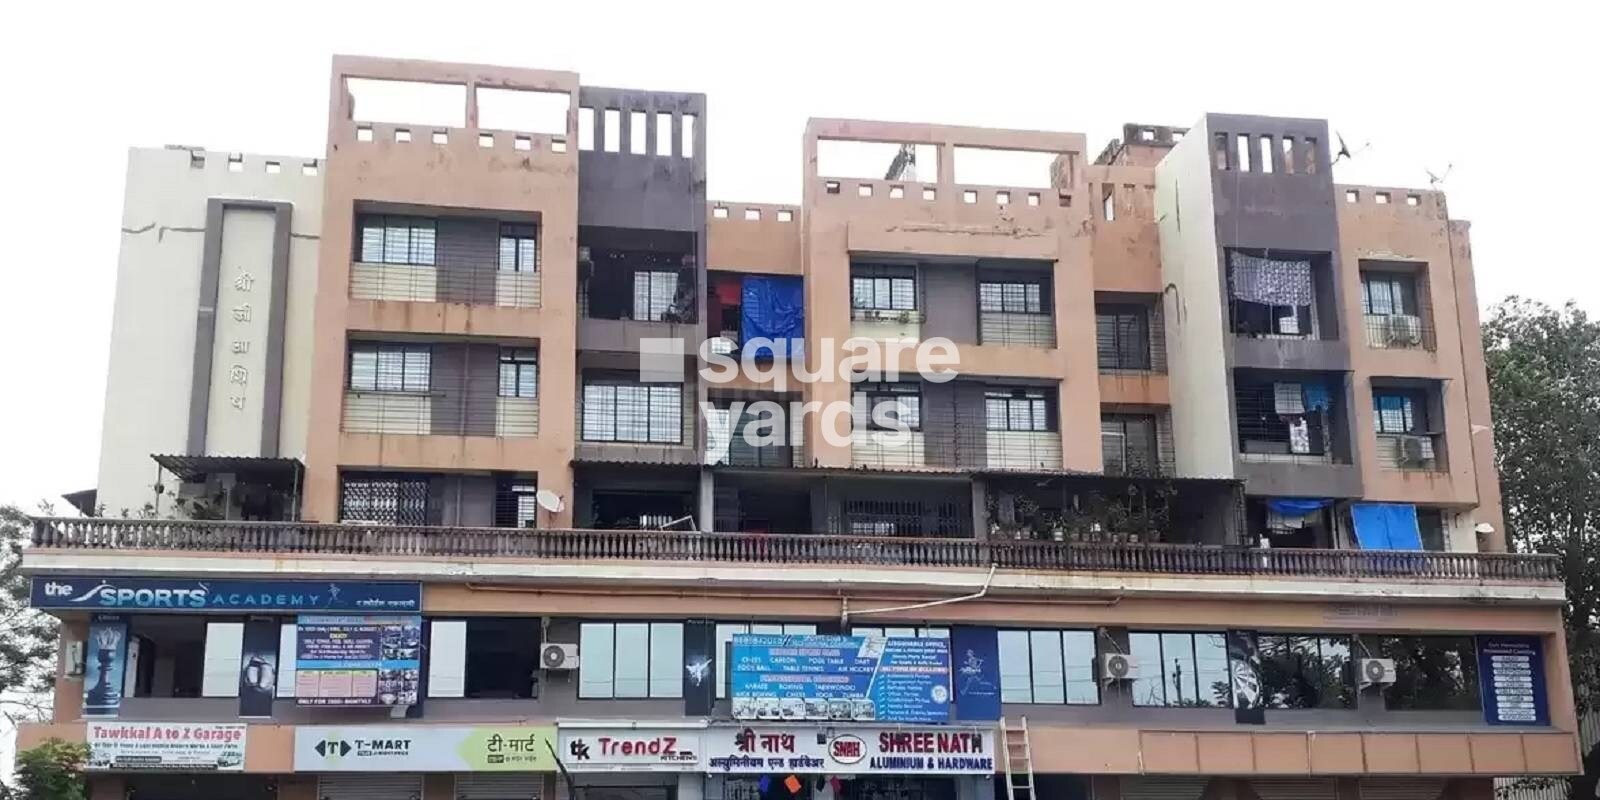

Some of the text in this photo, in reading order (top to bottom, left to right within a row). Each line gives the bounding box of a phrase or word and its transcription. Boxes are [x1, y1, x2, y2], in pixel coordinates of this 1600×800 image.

[44, 582, 319, 607] the SPORTS ACADEMY
[152, 727, 162, 740] A
[165, 727, 180, 740] to
[183, 728, 192, 740] Z
[193, 728, 241, 742] Garage
[734, 728, 795, 753] श्री नाथ
[879, 732, 982, 753] SHREE NATH
[355, 739, 411, 750] T-MART
[598, 736, 677, 755] TrendZ
[870, 757, 992, 770] ALUMINIUM & HARDWARE
